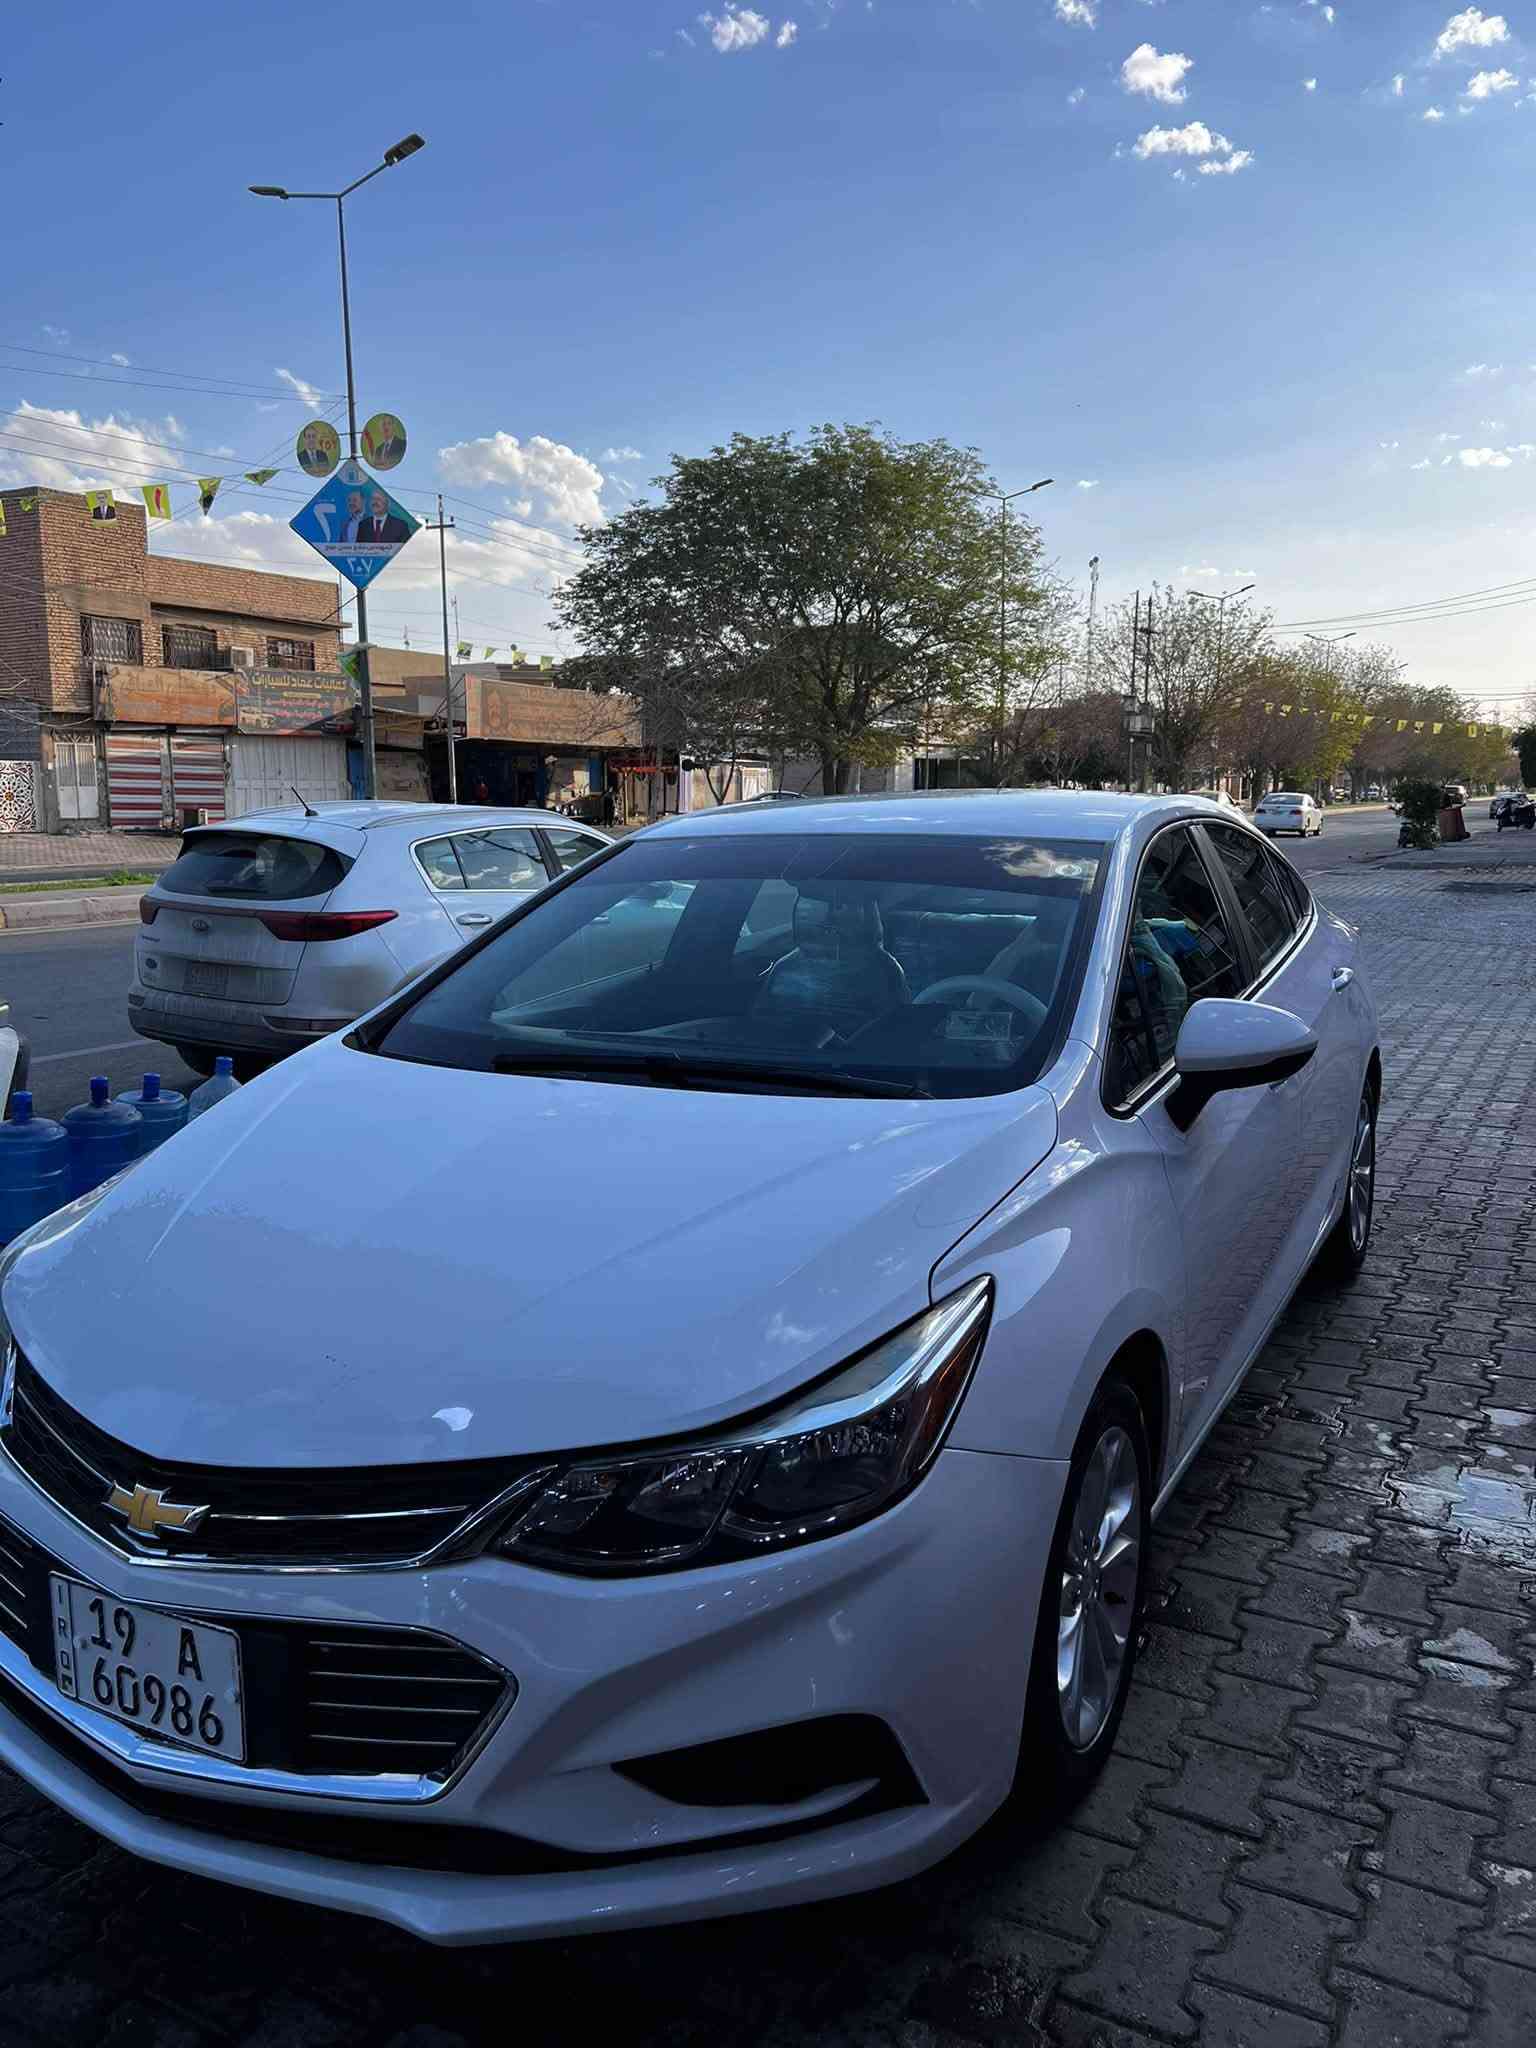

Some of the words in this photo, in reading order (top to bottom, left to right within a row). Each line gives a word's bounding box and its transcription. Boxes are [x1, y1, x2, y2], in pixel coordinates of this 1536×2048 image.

[346, 557, 373, 575] ٢٠٧
[252, 672, 290, 689] للسيارات
[89, 1597, 136, 1657] 19
[178, 1627, 203, 1682] A
[92, 1656, 223, 1746] 60986
